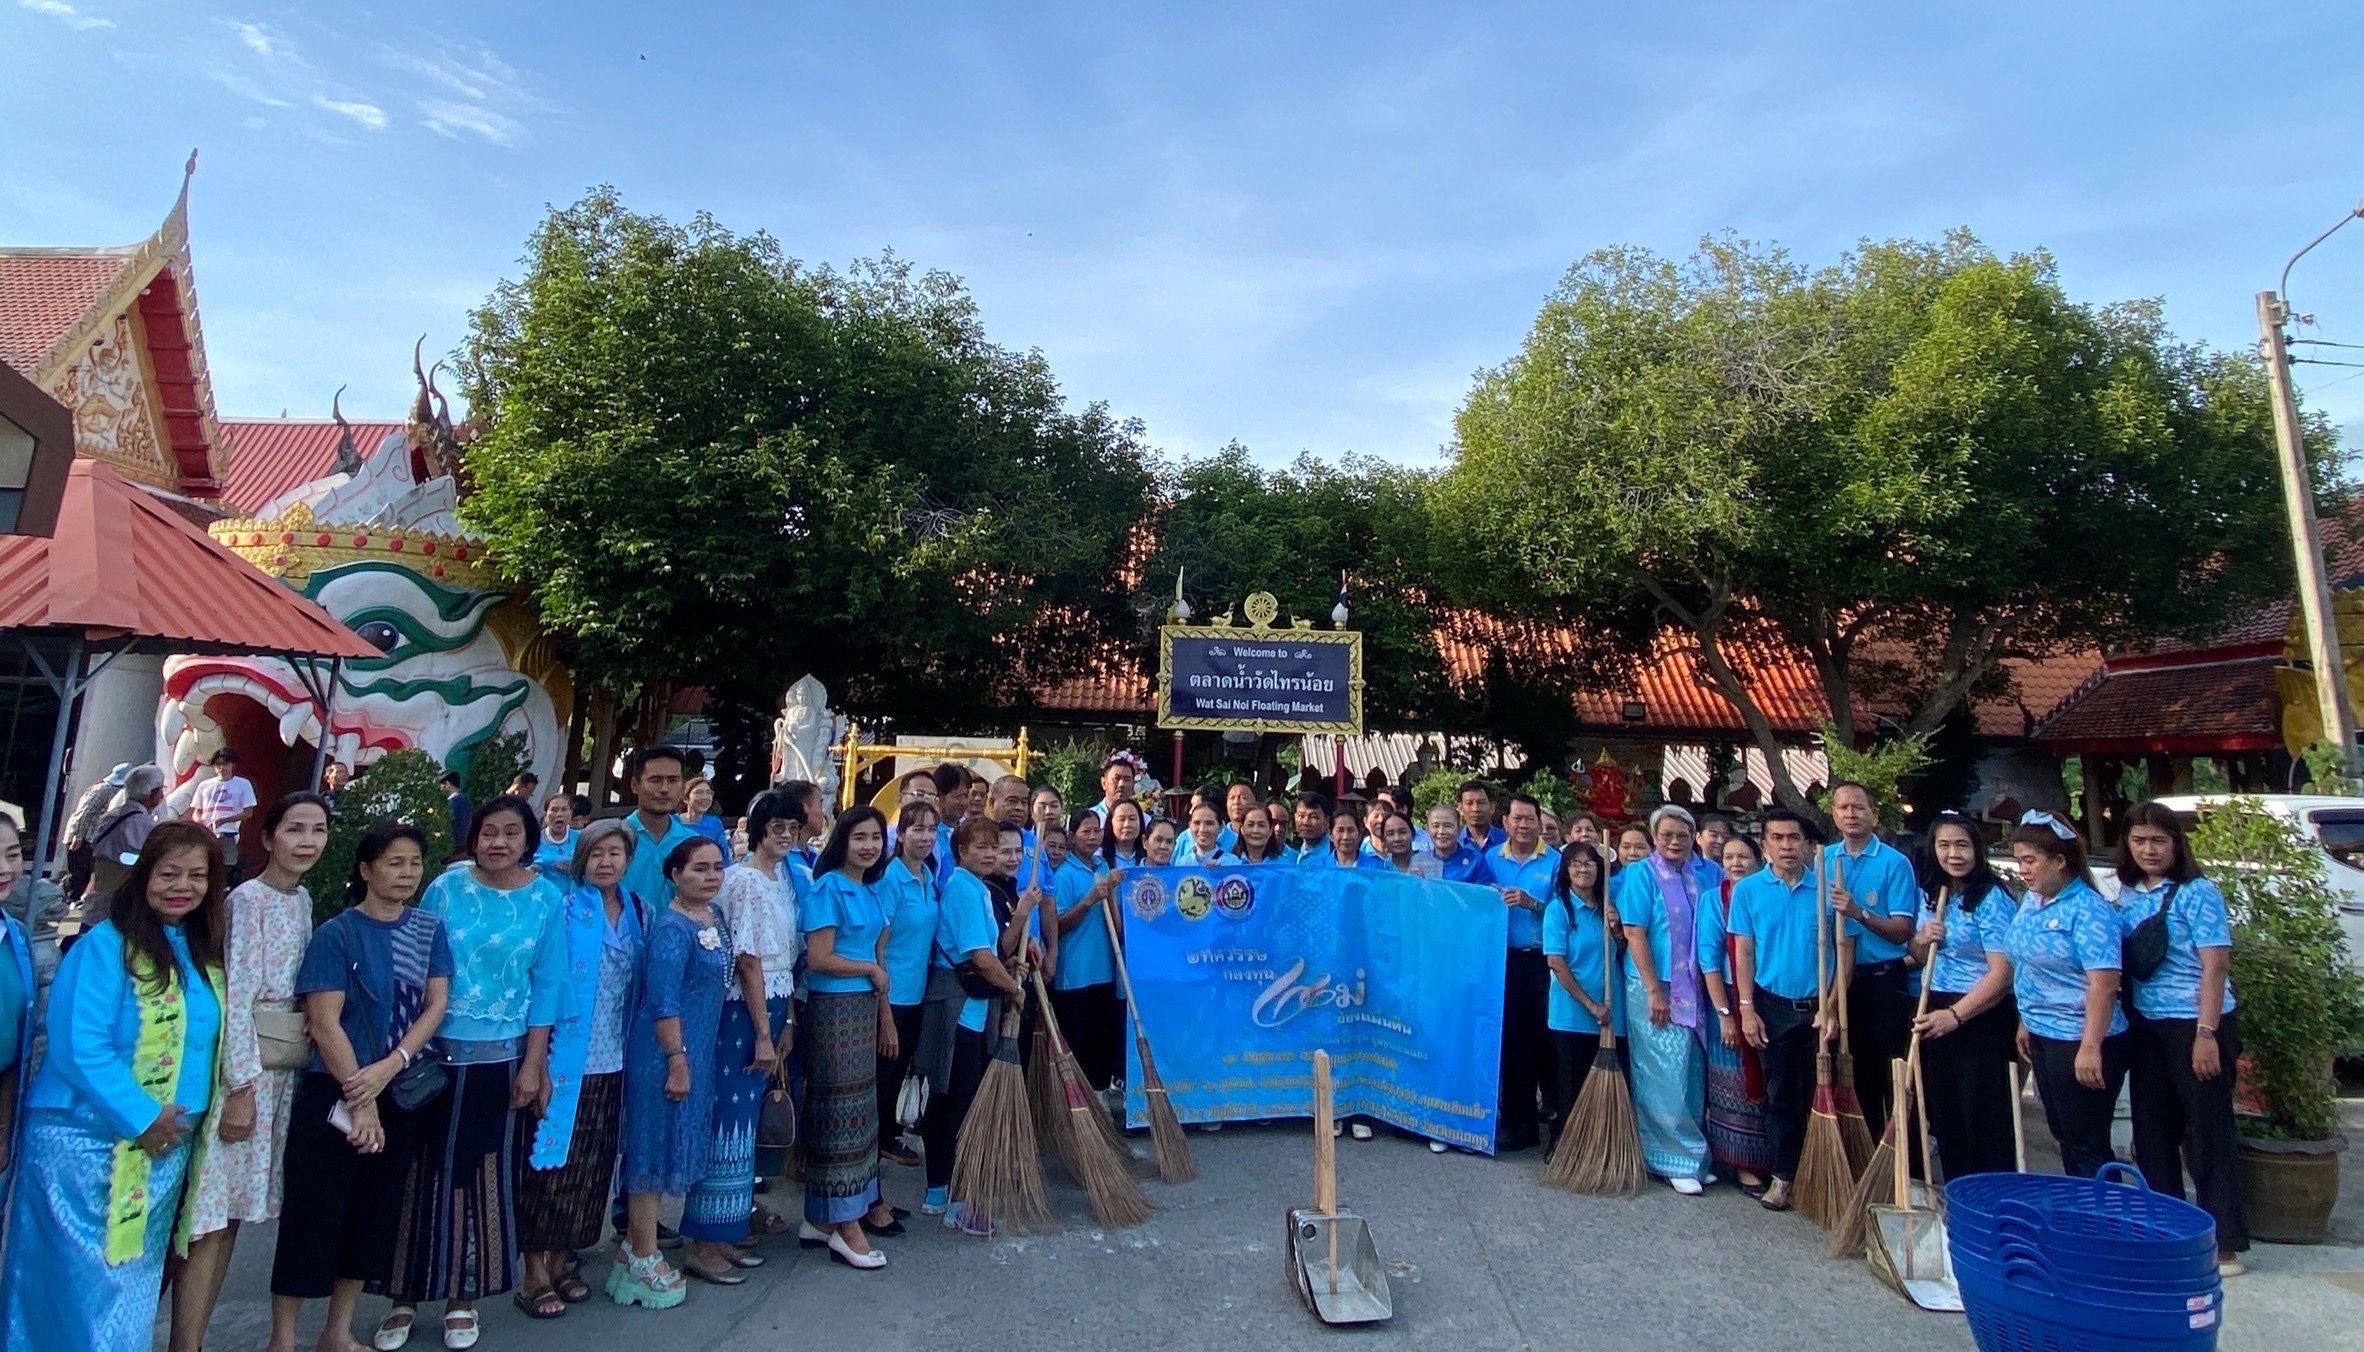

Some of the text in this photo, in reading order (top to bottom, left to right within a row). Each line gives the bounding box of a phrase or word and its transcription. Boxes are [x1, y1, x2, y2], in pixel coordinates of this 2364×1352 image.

[1233, 646, 1288, 658] Welcome to
[1189, 664, 1334, 692] ตลาดน้ำวัดไทรน้อย
[1195, 697, 1324, 714] Wat Sai Noi Floating Market
